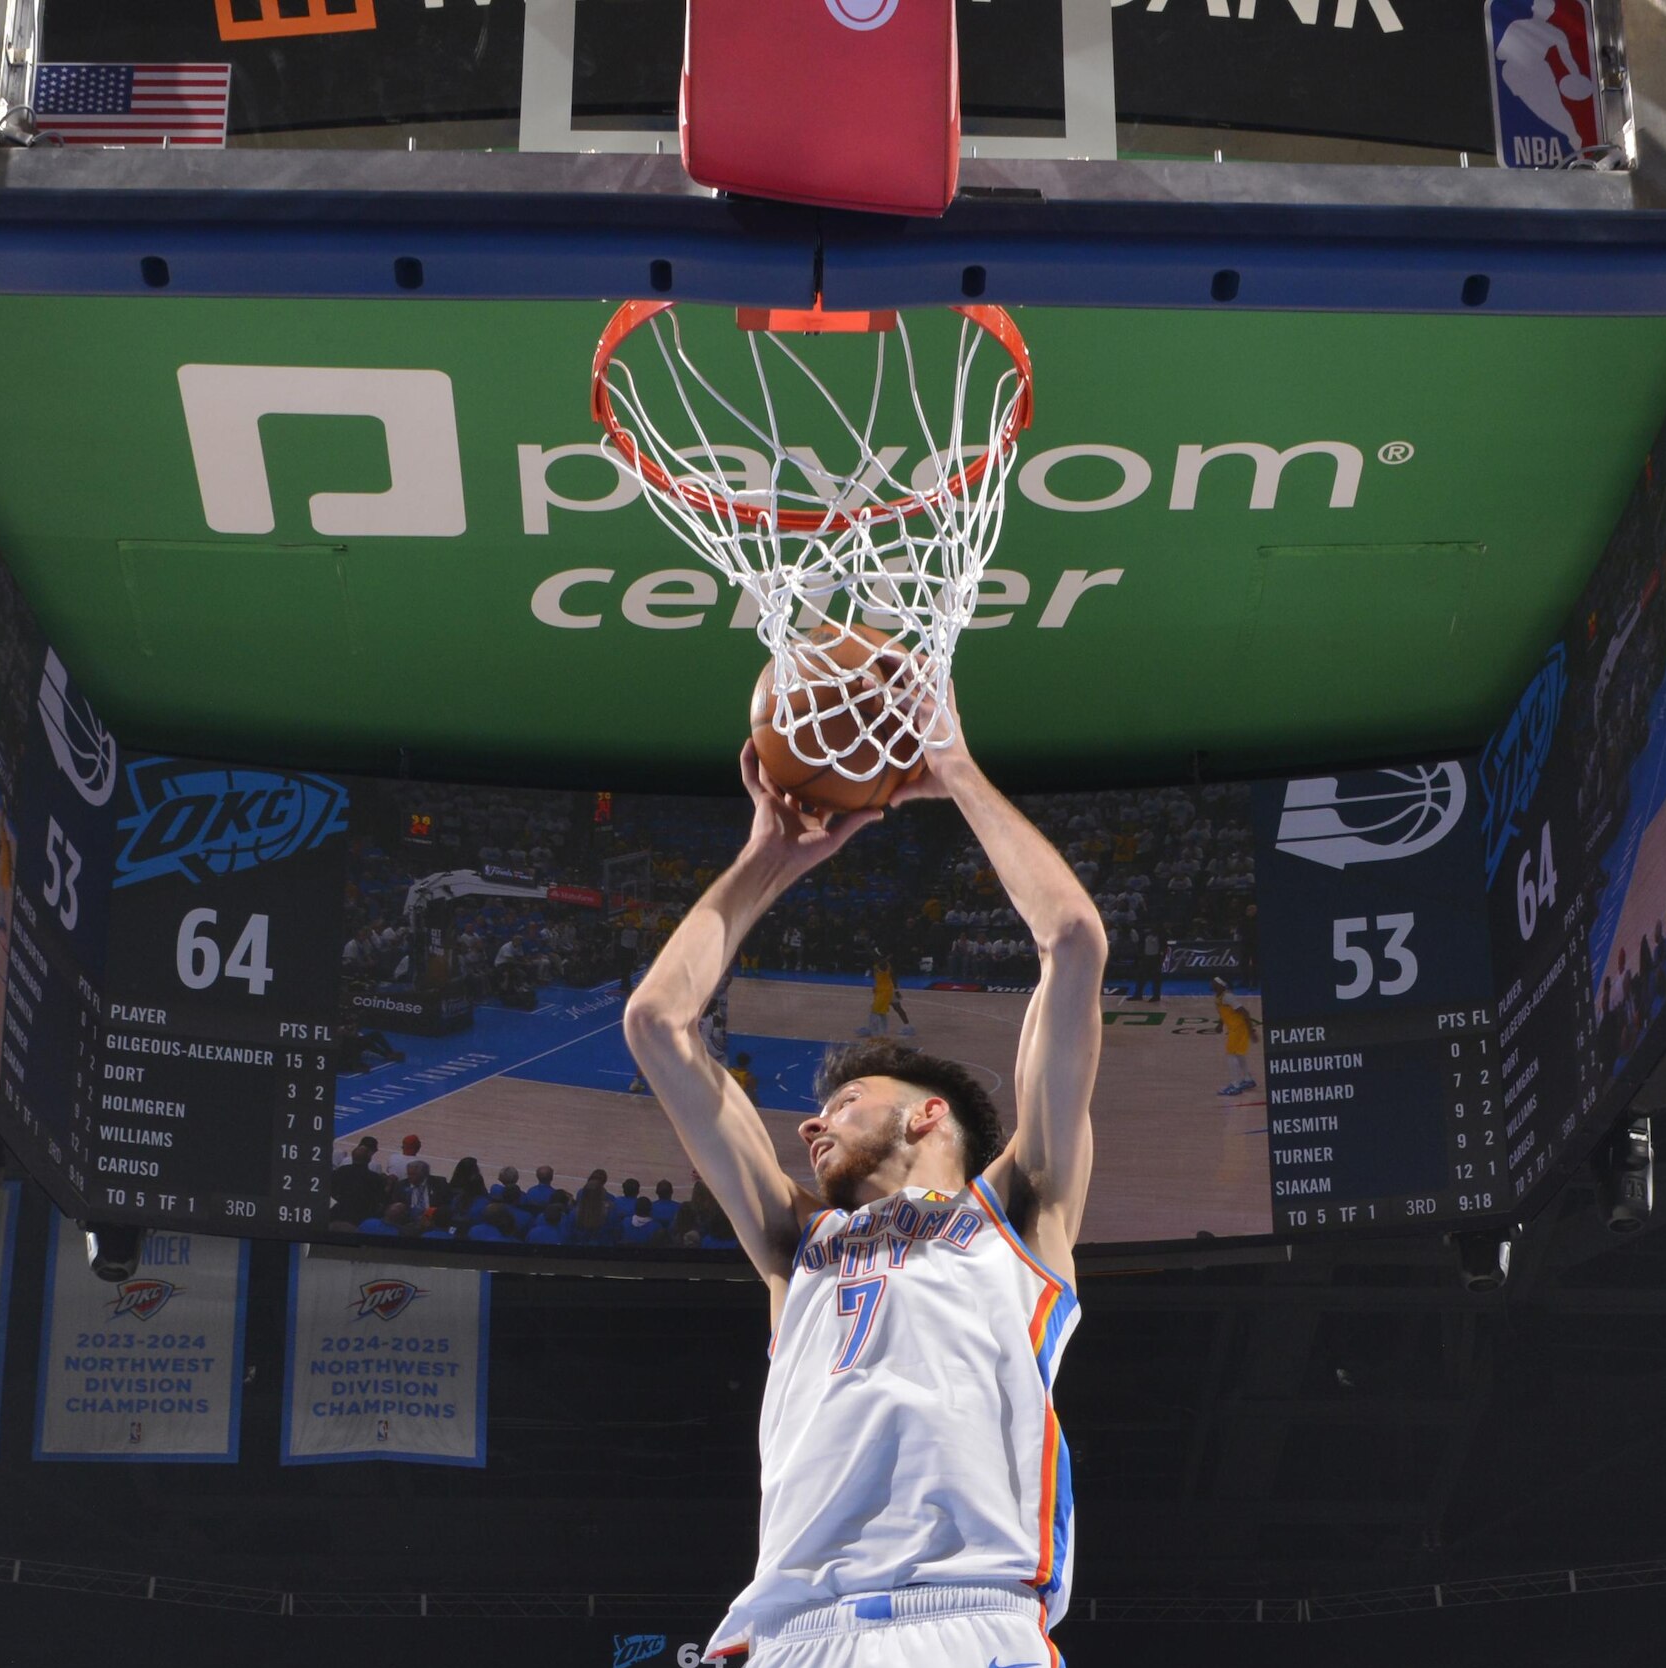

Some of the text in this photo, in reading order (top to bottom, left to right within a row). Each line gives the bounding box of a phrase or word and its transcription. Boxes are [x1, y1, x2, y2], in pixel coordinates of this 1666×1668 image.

[1513, 135, 1566, 168] NBA
[530, 567, 1125, 631] center
[42, 814, 83, 931] 53
[1516, 819, 1559, 942] 64
[176, 907, 274, 996] 64
[1332, 911, 1420, 1001] 53
[351, 995, 423, 1015] coinbase
[110, 1004, 332, 1042] PLAYER PTS FL
[1270, 1009, 1491, 1045] PLAYER PTS FL
[106, 1034, 303, 1070] GILGEOUS-ALEXANDER 15
[1269, 1053, 1364, 1075] HALIBURTON
[104, 1064, 145, 1083] DORT
[101, 1094, 186, 1119] HOLMGREN
[1270, 1083, 1355, 1105] NEMBHARD
[1272, 1115, 1339, 1135] NESMITH
[99, 1124, 299, 1160] WILLIAMS 16
[97, 1155, 160, 1178] CARUSO
[1273, 1147, 1334, 1166] TURNER
[1275, 1163, 1474, 1196] SIAKAM 12
[106, 1188, 313, 1225] TO TF 3RD 9:18
[1287, 1192, 1493, 1227] TO TF 3RD 9:18
[841, 1231, 914, 1278] ITY
[830, 1275, 888, 1376] 7
[76, 1333, 208, 1350] 2023-2024
[321, 1336, 450, 1354] 2024-2025
[64, 1356, 215, 1374] NORTHWEST
[310, 1359, 460, 1378] NORTHWEST
[84, 1377, 194, 1395] DIVISION
[331, 1380, 440, 1398] DIVISION
[65, 1398, 210, 1415] CHAMPIONS
[312, 1402, 457, 1420] CHAMPIONS
